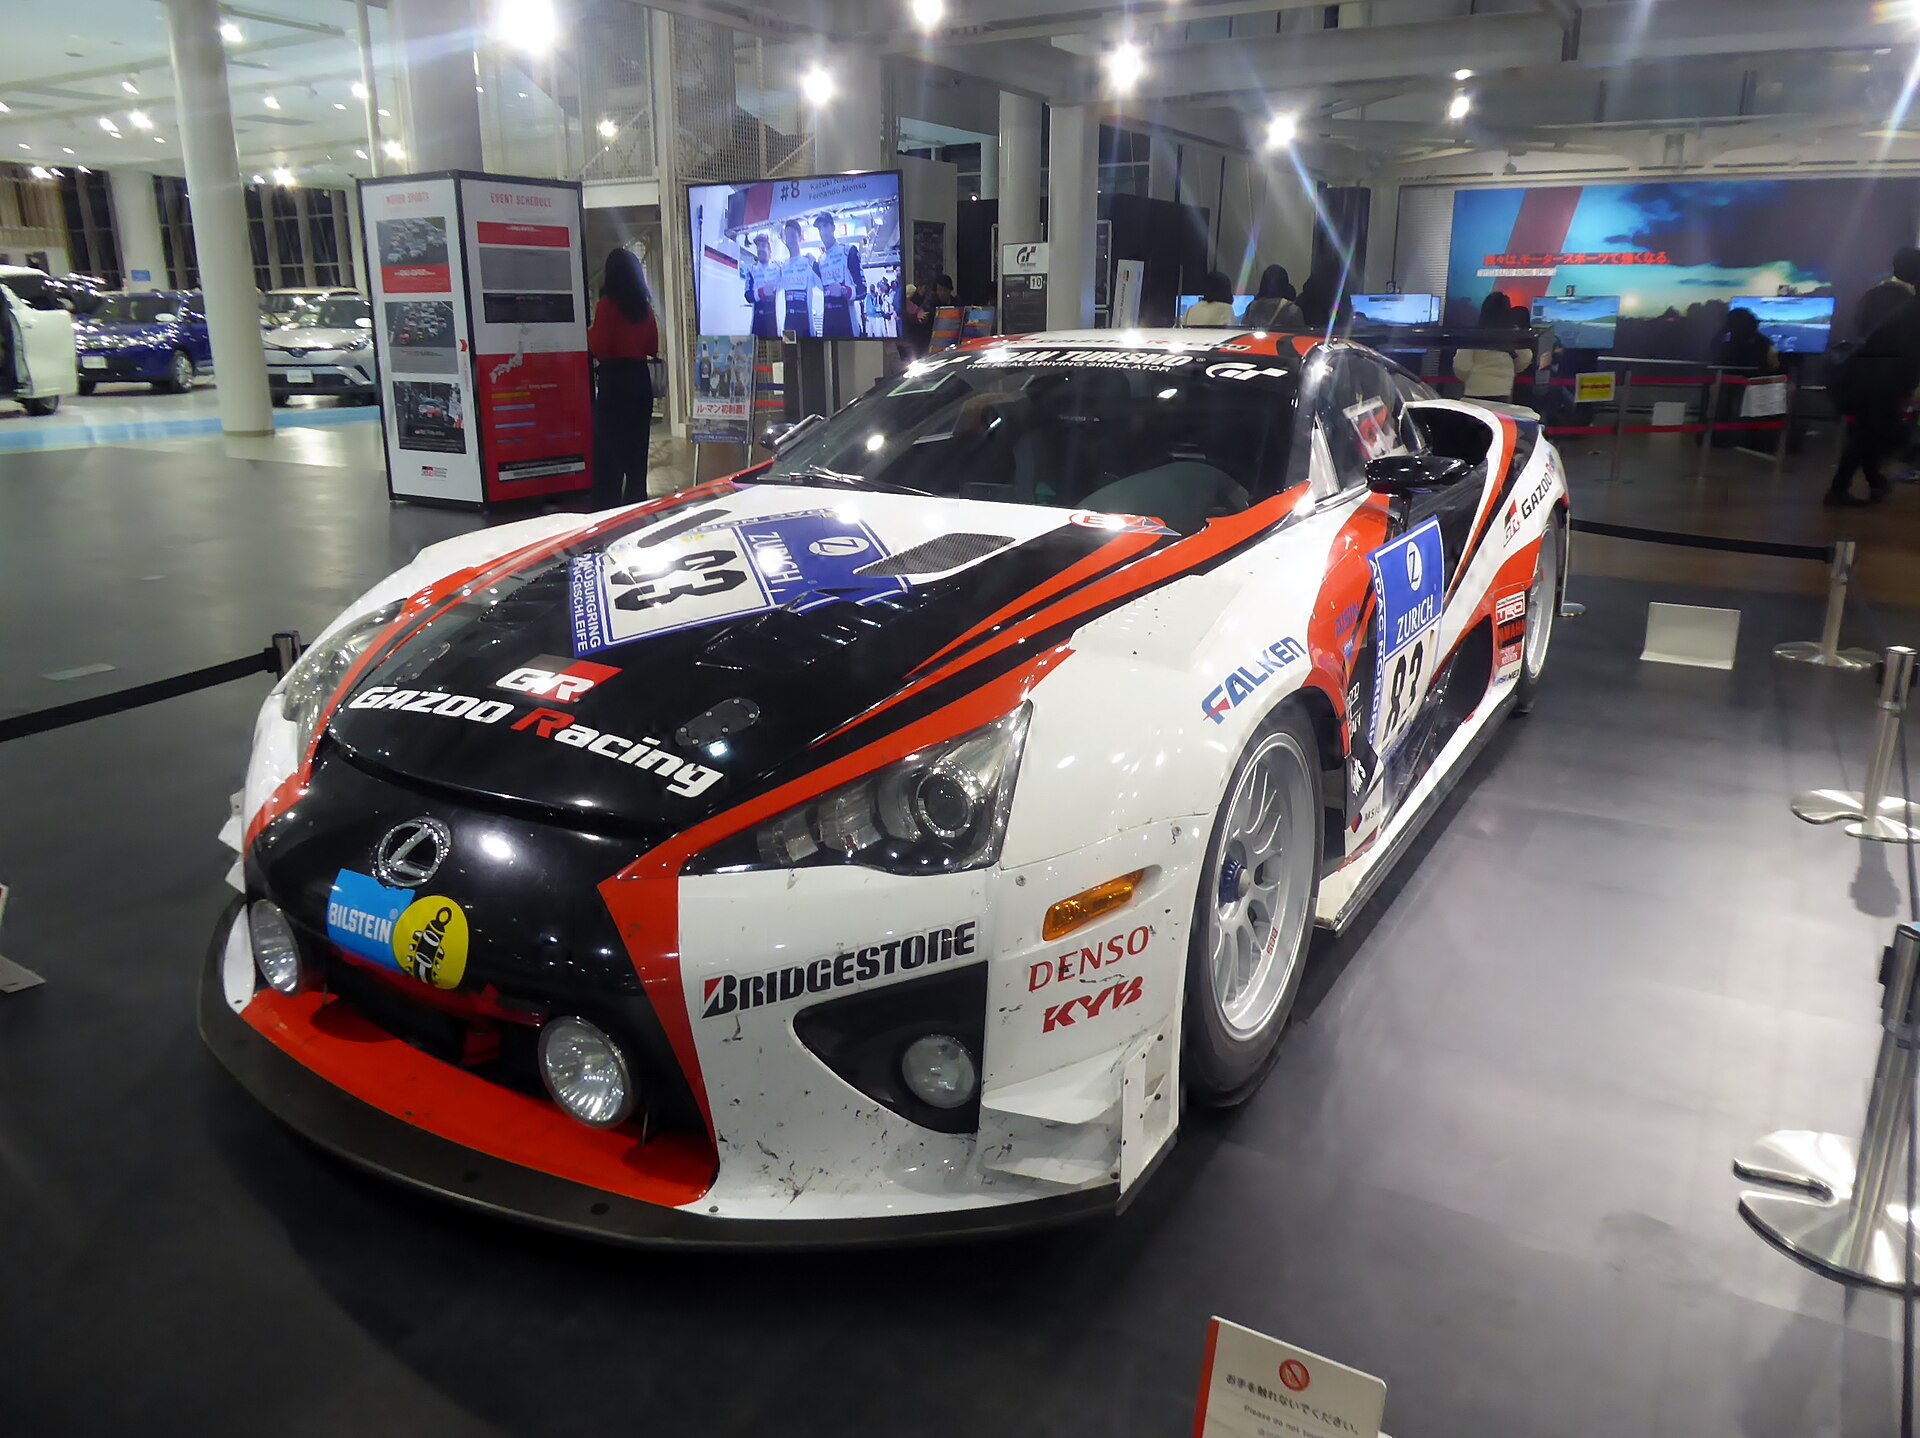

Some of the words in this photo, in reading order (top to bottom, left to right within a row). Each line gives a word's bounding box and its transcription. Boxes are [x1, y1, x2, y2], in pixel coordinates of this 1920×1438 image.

[490, 192, 513, 205] EVENT
[516, 194, 552, 208] SCHEDULE
[780, 180, 800, 201] #8
[1032, 277, 1042, 288] 10
[991, 361, 1025, 369] REAL
[1086, 361, 1171, 373] SIMULATOR
[1058, 350, 1193, 367] TURISMO
[1521, 472, 1553, 520] GAZOO
[1369, 558, 1385, 632] ADAC
[1497, 600, 1523, 621] TRD
[1396, 594, 1434, 645] ZURICH
[496, 667, 595, 701] GR
[1201, 636, 1306, 725] FALKEN
[349, 686, 516, 724] GAZOO
[510, 706, 724, 798] Racing
[328, 902, 393, 945] BILSTEIN
[701, 920, 976, 1019] BRIDGESTONE
[1028, 925, 1149, 992] DENSO
[1042, 974, 1144, 1034] KYB
[1243, 1404, 1271, 1422] Please
[1273, 1417, 1284, 1427] do
[1286, 1423, 1300, 1434] not
